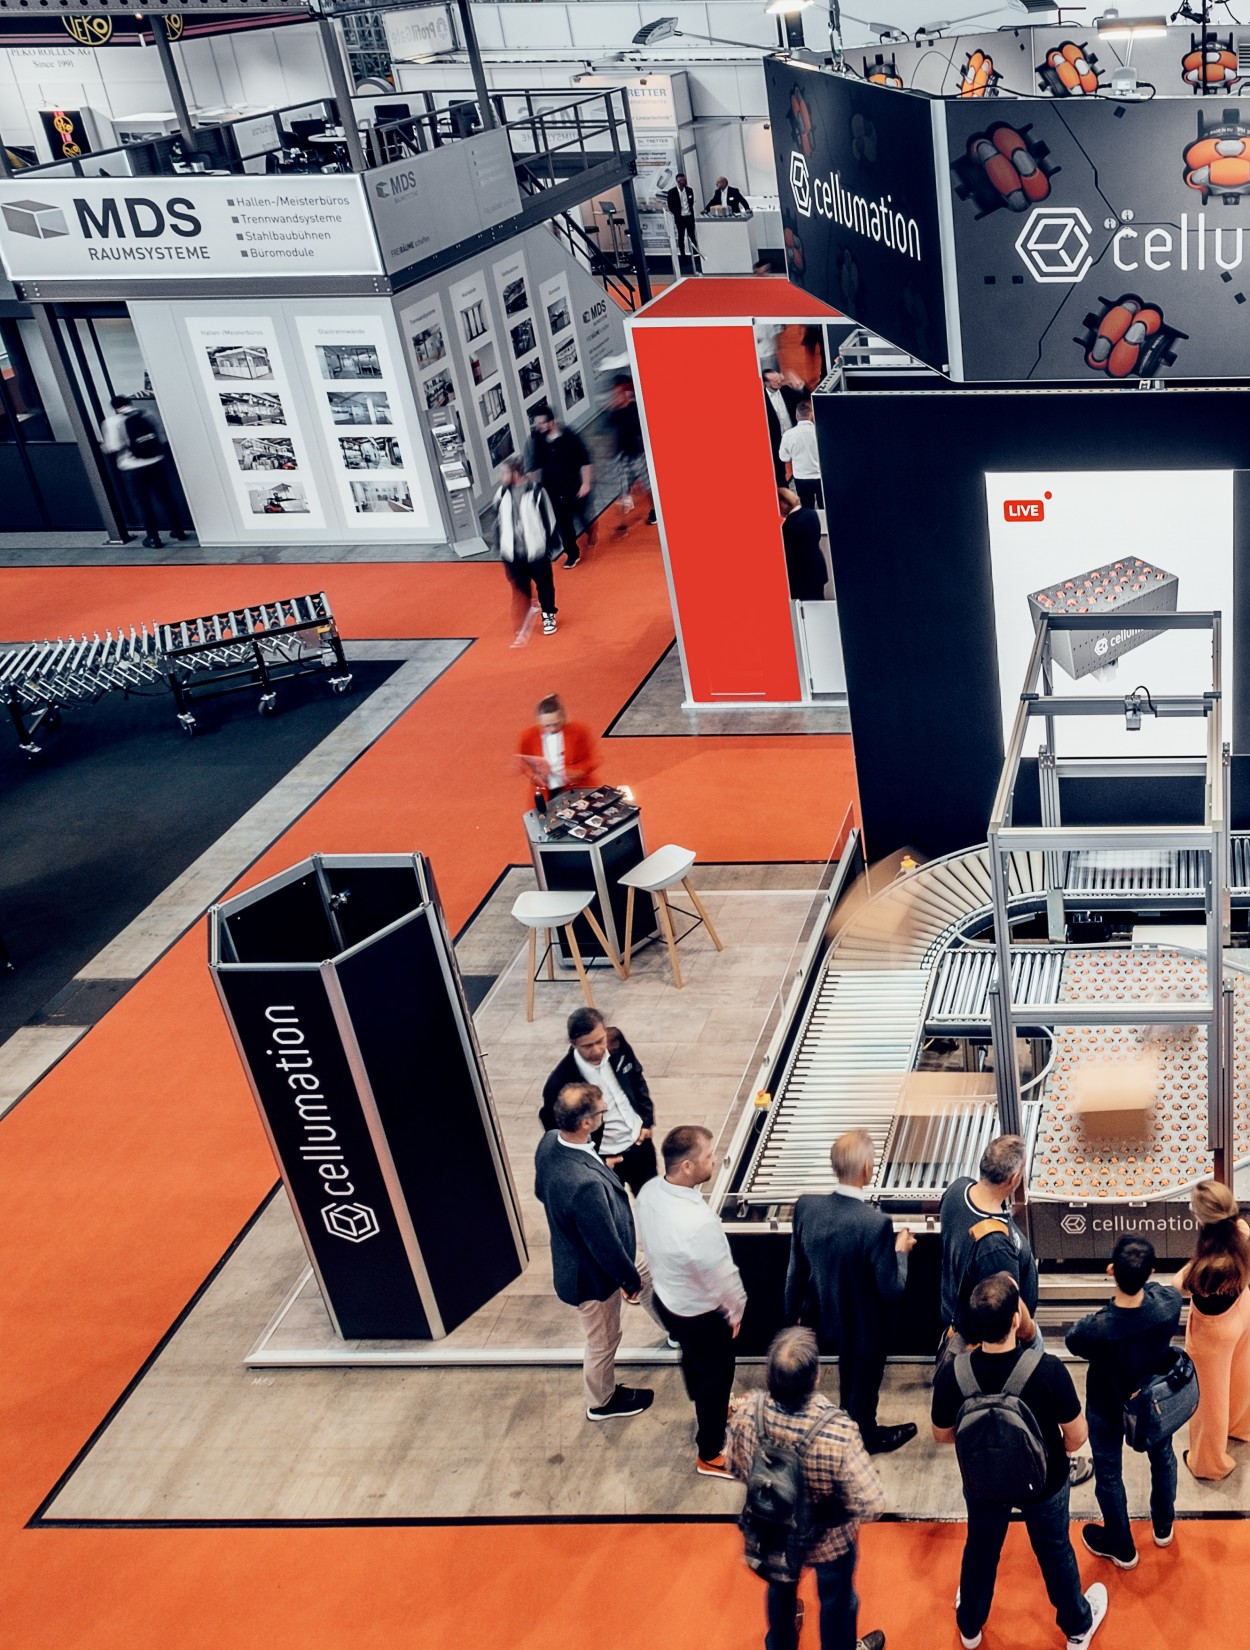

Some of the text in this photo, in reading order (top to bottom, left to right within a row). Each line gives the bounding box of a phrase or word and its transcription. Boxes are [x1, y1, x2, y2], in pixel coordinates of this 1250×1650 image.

[33, 59, 55, 68] Since
[627, 89, 667, 97] RETTER
[390, 171, 416, 196] MDS
[236, 196, 350, 207] Hallen-/Meisterbüros
[73, 197, 202, 239] MDS
[241, 213, 343, 226] Trennwandsysteme
[813, 171, 921, 261] cellumation
[245, 230, 331, 242] Stahlbaubühnen
[88, 246, 211, 262] RAUMSYSTEME
[250, 247, 315, 258] Büromodule
[1008, 504, 1039, 518] LIVE
[1110, 629, 1143, 647] cellum
[265, 1005, 355, 1196] cellumation
